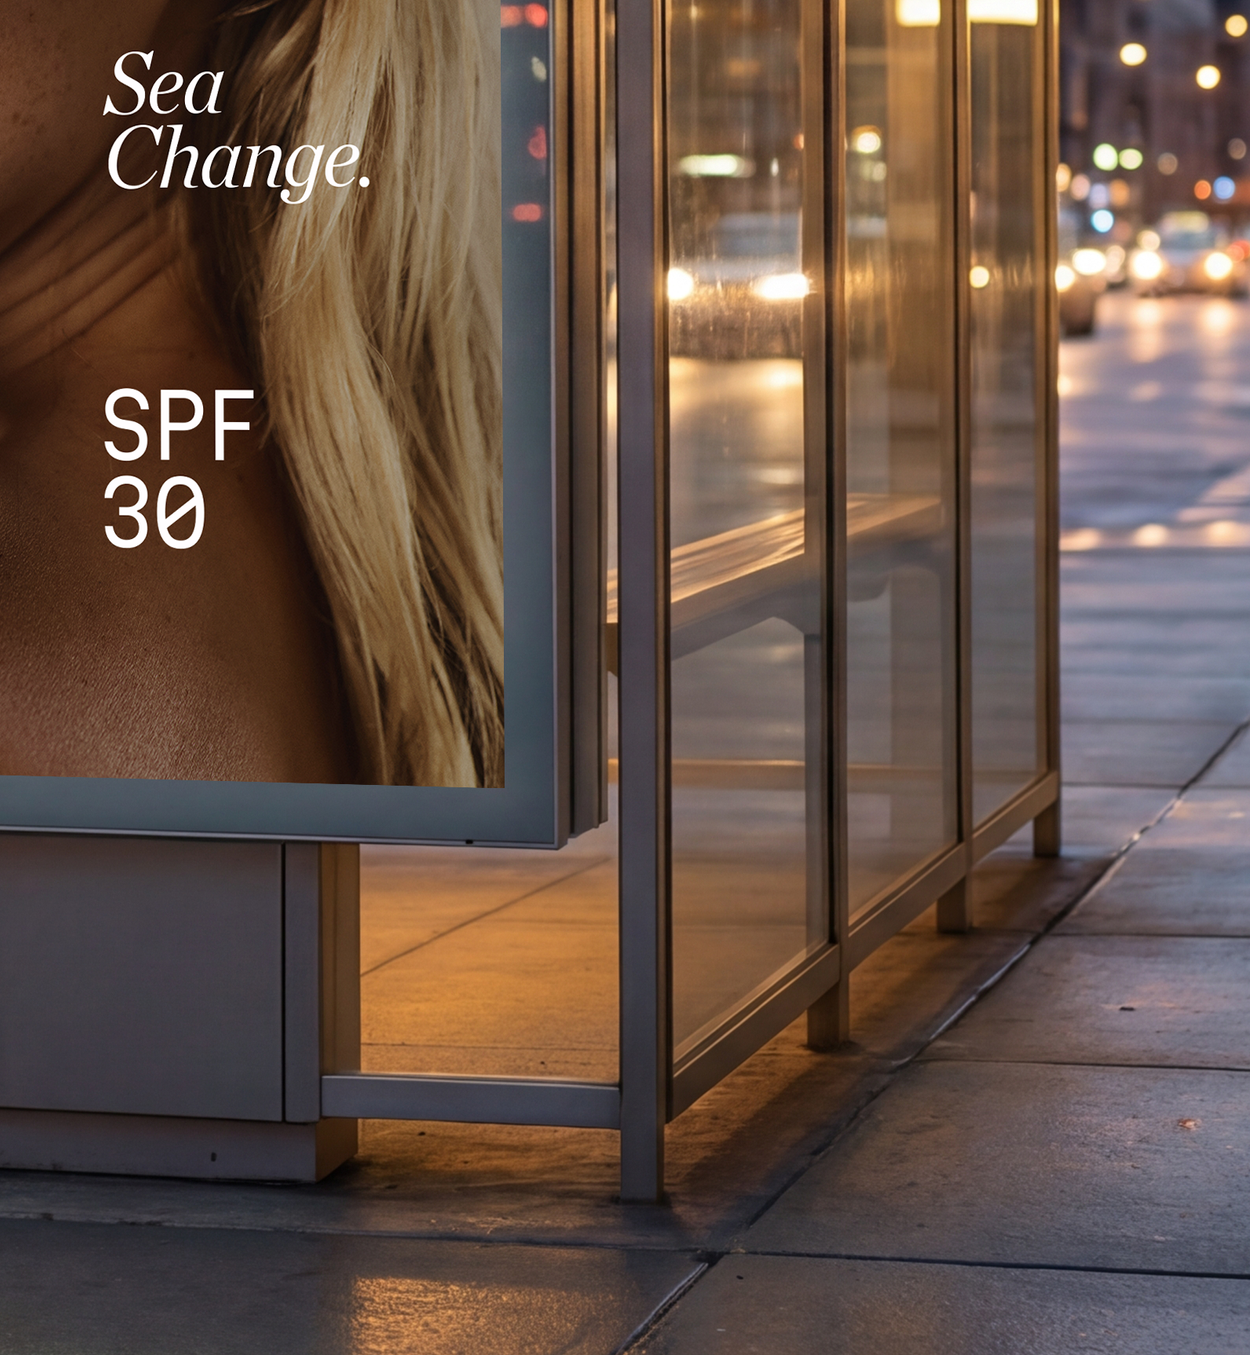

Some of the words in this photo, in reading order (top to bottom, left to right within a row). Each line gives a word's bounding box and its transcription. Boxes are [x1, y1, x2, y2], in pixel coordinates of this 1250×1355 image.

[102, 50, 224, 116] Sea
[108, 124, 370, 205] Change.
[104, 388, 254, 462] SPF
[104, 475, 205, 549] 30
